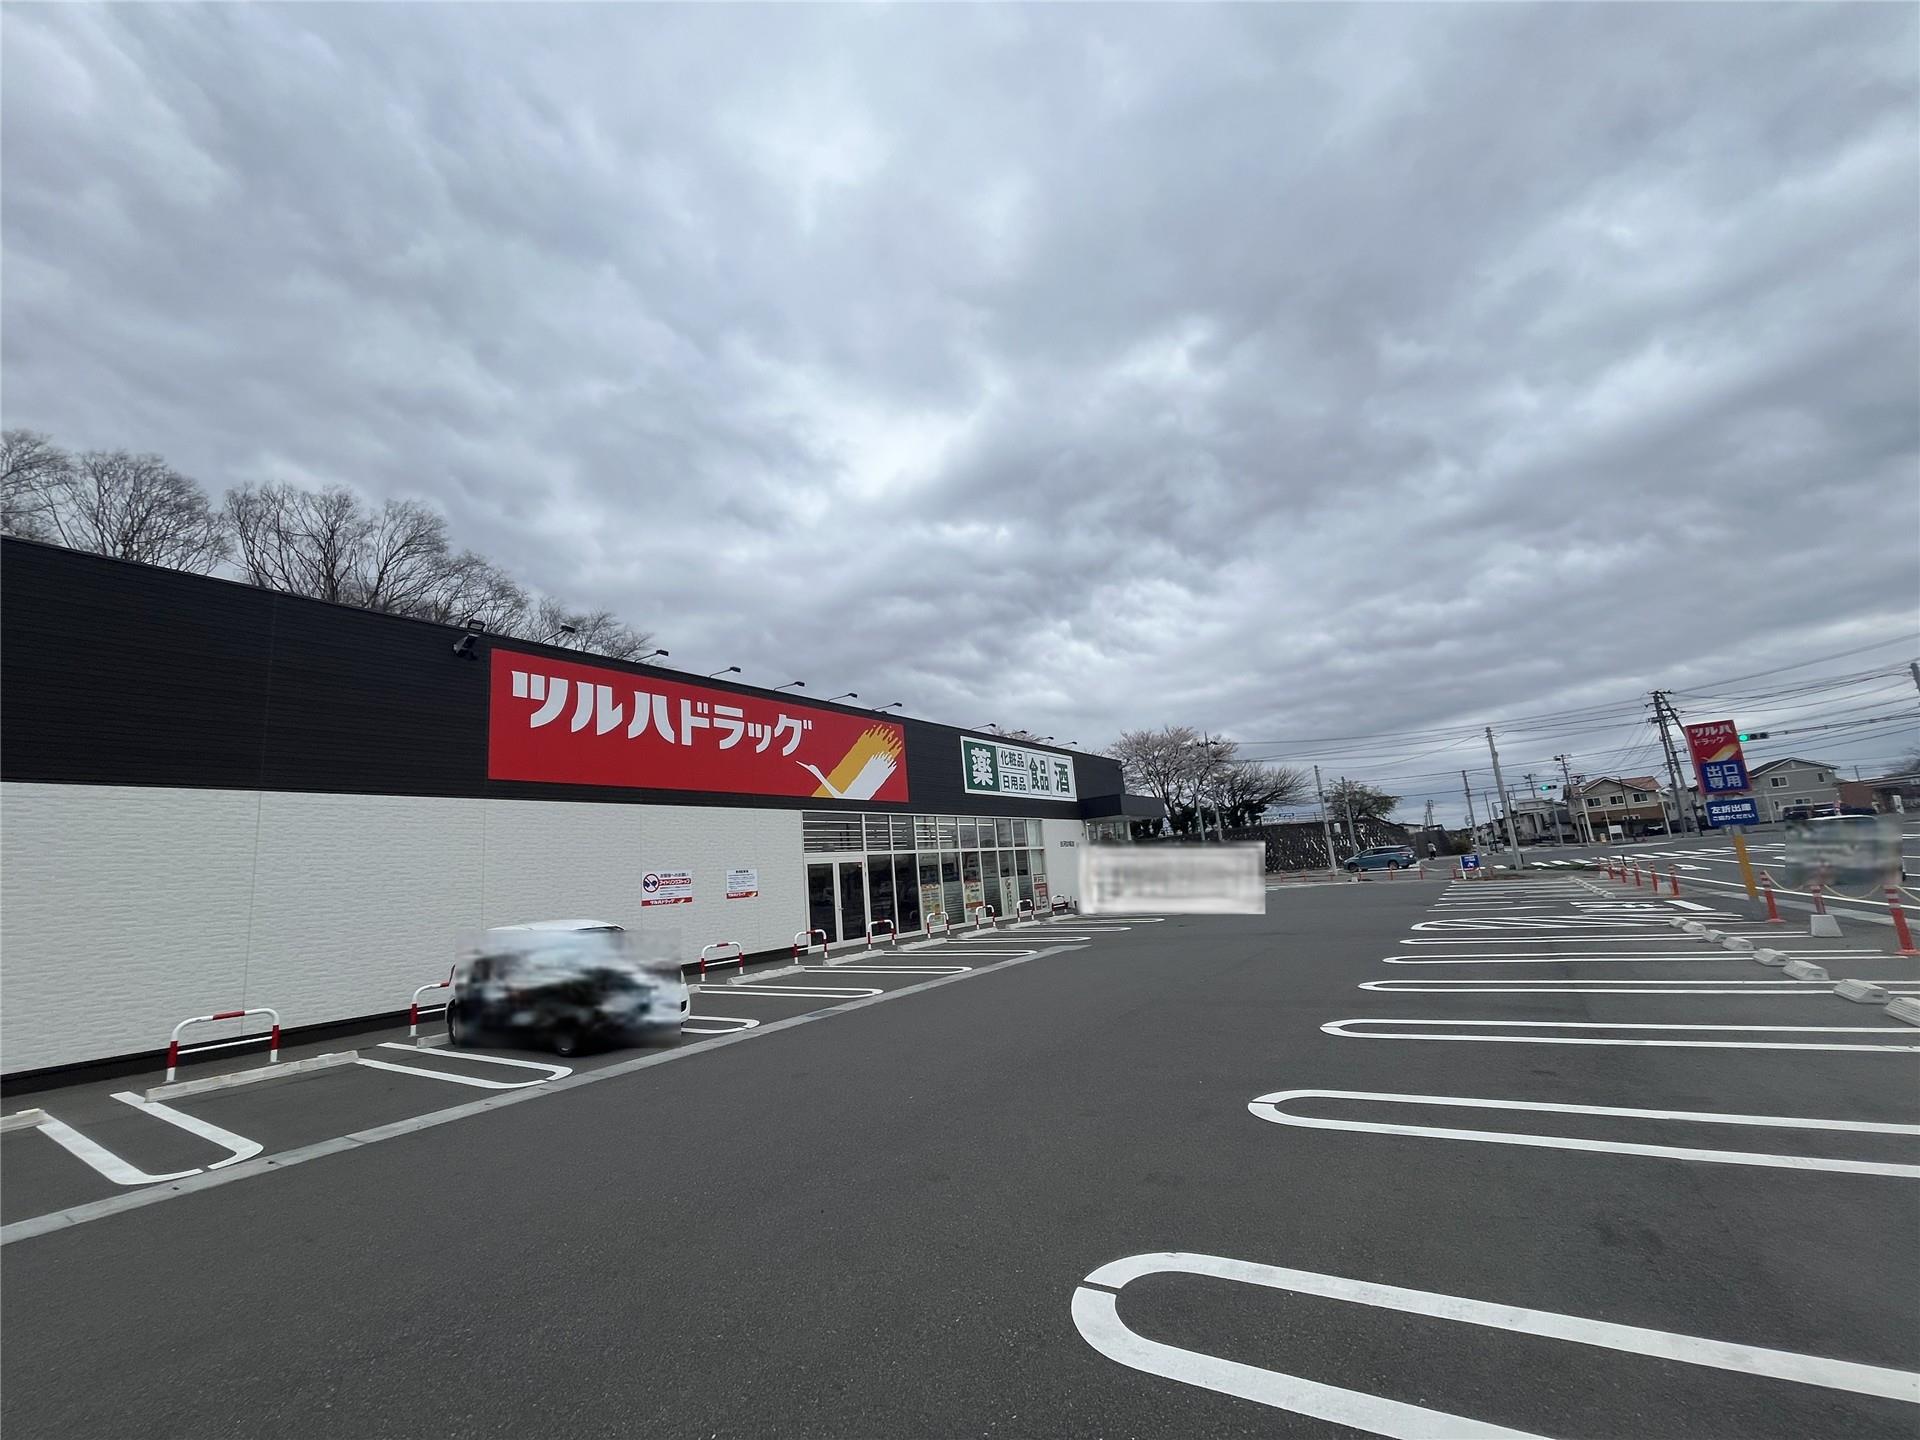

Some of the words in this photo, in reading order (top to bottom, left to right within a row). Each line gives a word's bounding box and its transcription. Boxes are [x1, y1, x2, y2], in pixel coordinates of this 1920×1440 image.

[511, 670, 812, 757] ツルハドラッグ
[1691, 724, 1733, 738] ツルハ
[1694, 735, 1726, 747] ドラッグ
[970, 747, 994, 786] 薬
[1000, 749, 1025, 768] 化粧品
[1029, 757, 1050, 791] 食品
[1054, 761, 1070, 793] 酒
[1707, 764, 1739, 778] 出口
[1002, 774, 1027, 791] 日用品
[1709, 776, 1742, 789] 専用
